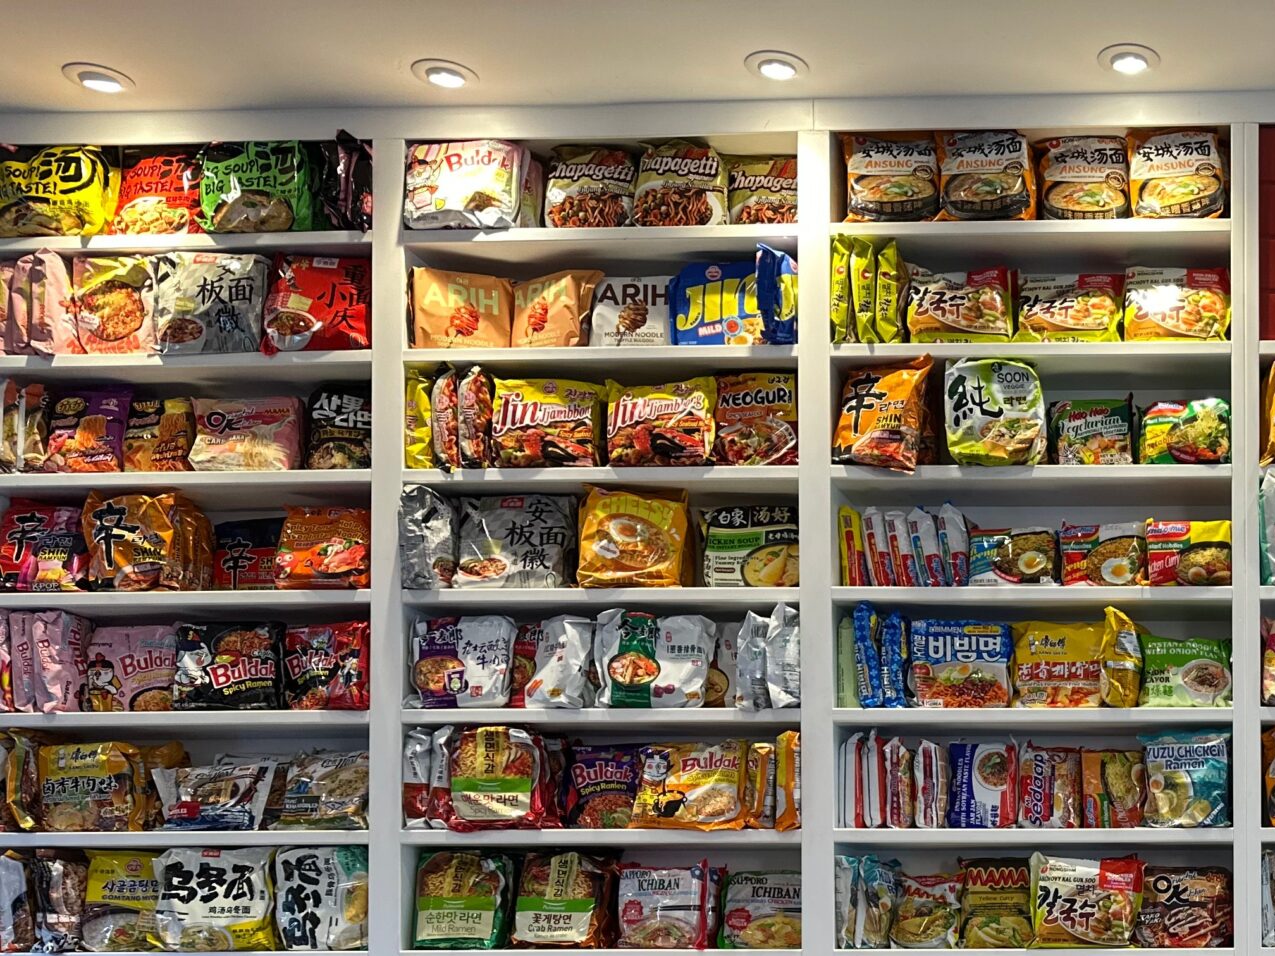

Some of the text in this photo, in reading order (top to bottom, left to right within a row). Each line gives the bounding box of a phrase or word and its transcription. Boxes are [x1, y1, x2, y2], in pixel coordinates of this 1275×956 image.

[865, 159, 913, 169] ANSUNG
[956, 158, 1004, 169] ANSUNG
[1060, 164, 1106, 174] ANSUNG
[1147, 159, 1195, 173] ANSUNG
[424, 284, 500, 315] ARIH
[997, 371, 1030, 384] SOON
[876, 413, 901, 423] SHIN
[7, 512, 49, 562] 辛
[92, 502, 139, 569] 辛
[504, 521, 568, 547] 板面
[208, 658, 276, 689] Buldak
[246, 679, 272, 691] Ramen
[1177, 745, 1225, 758] CHICKEN
[1164, 759, 1205, 770] Ramen
[571, 763, 635, 788] Buldak
[966, 866, 1029, 888] MAMA
[637, 876, 681, 892] ICHIBAN
[460, 912, 483, 922] 라면
[431, 924, 477, 934] Mild Ramen
[546, 923, 574, 933] Ramen
